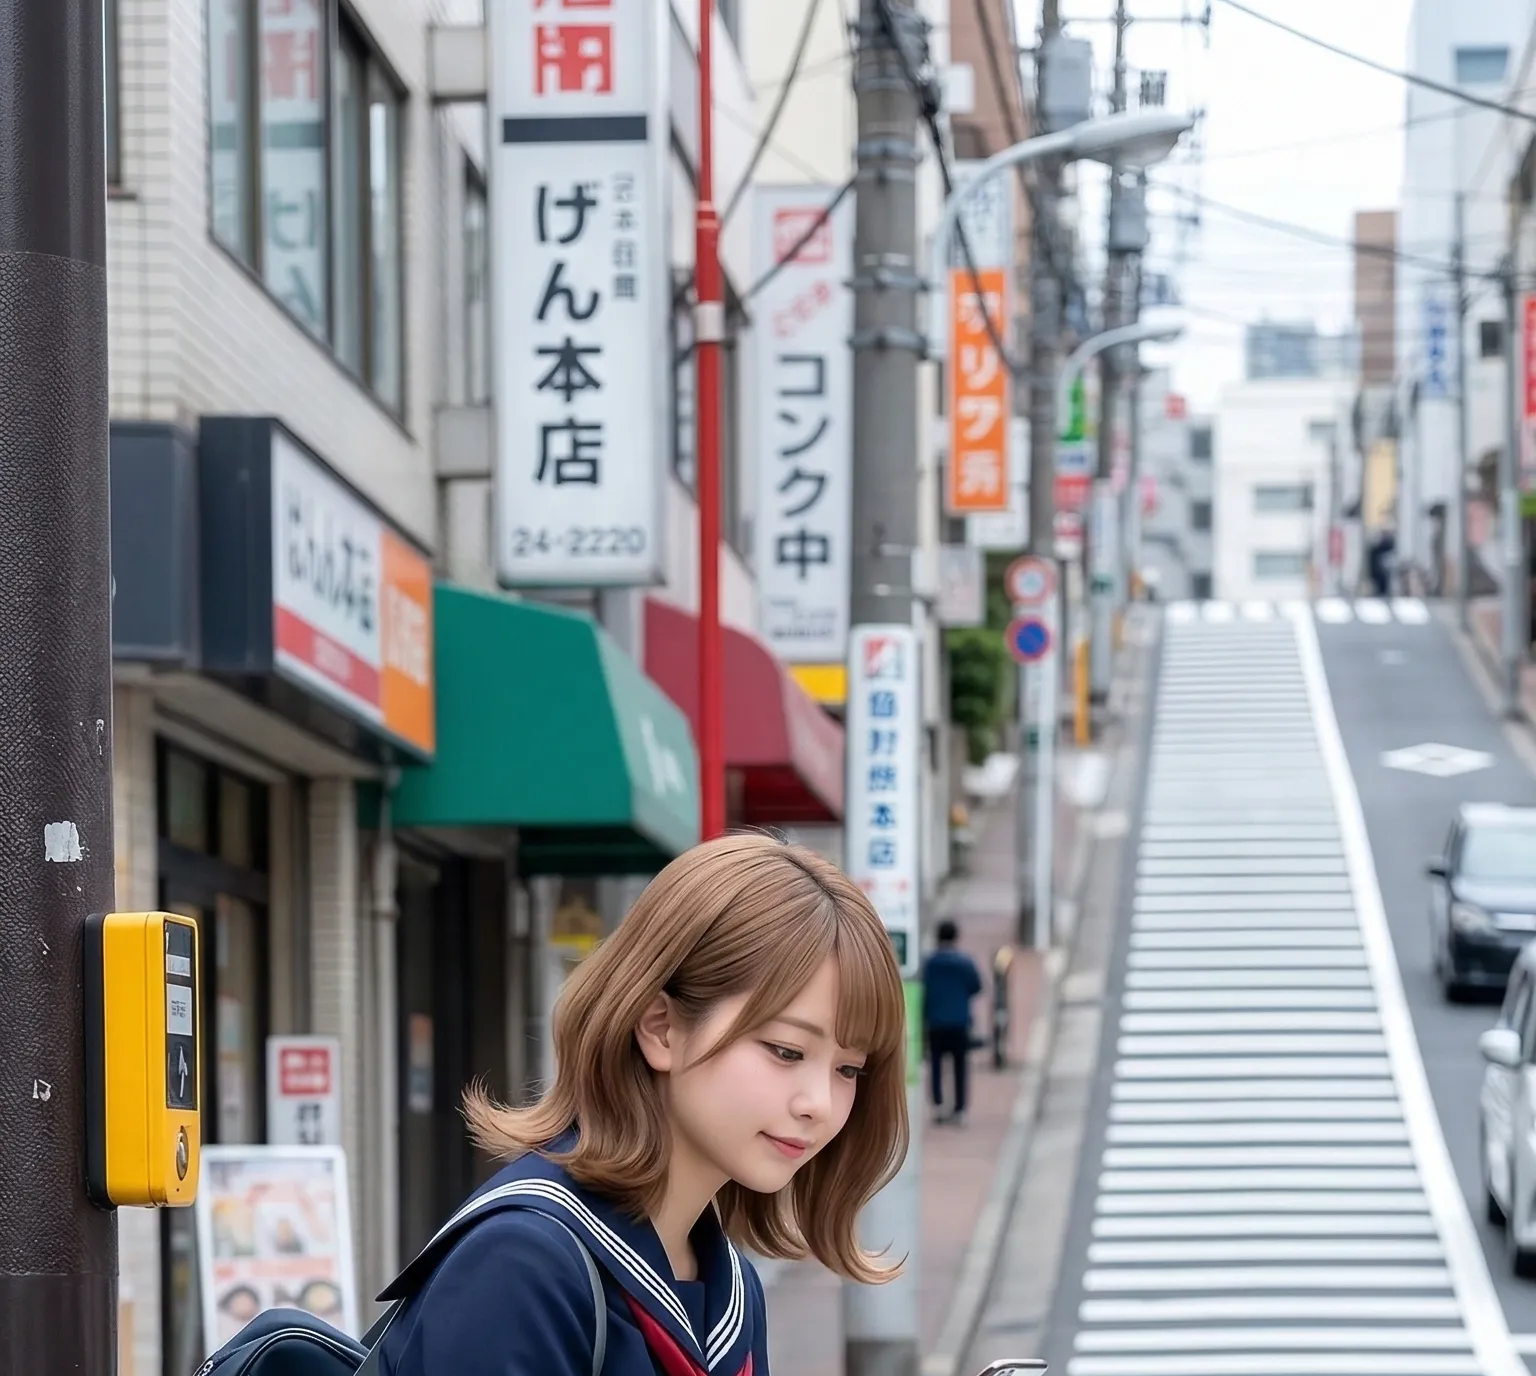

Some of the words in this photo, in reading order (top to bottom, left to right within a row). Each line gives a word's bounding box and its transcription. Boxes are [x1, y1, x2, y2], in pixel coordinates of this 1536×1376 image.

[534, 183, 603, 487] げん本店
[777, 352, 829, 579] コンク中
